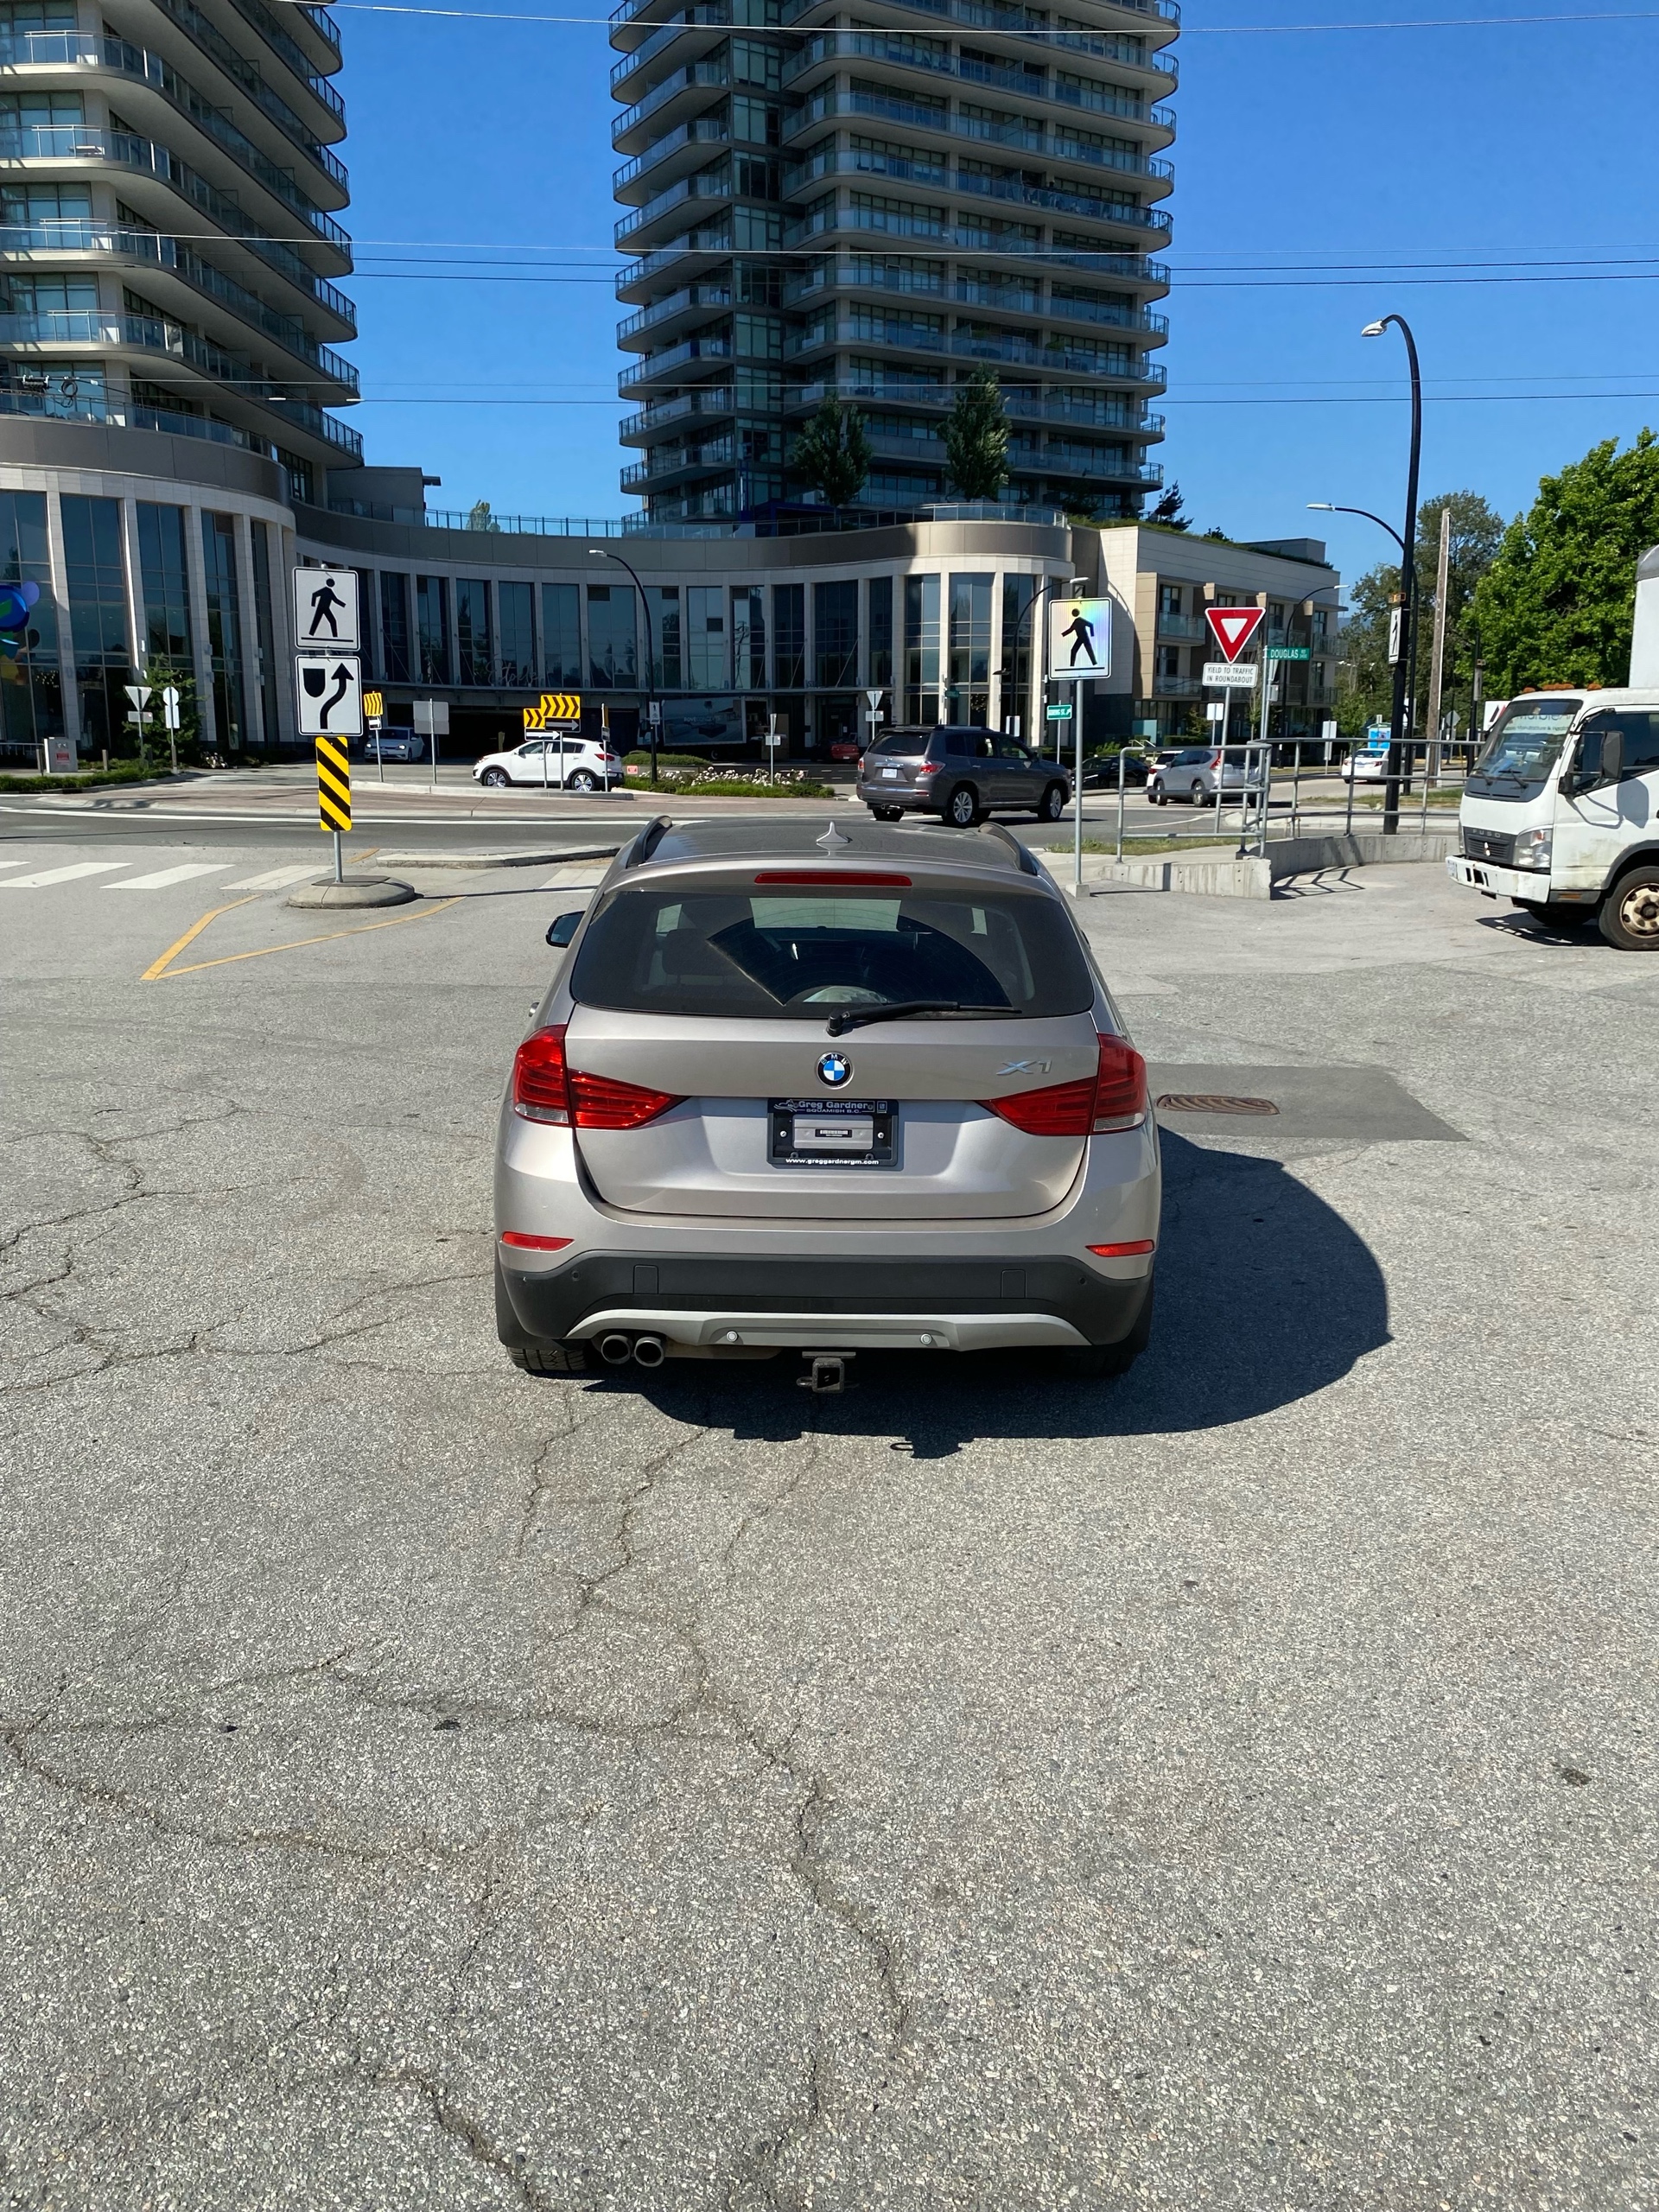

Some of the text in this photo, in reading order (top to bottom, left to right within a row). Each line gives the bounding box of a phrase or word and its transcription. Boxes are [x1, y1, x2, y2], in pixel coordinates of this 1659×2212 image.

[1270, 649, 1299, 658] DOUGLAS
[1472, 828, 1501, 838] FUSO
[820, 1053, 849, 1065] BMW
[995, 1060, 1052, 1075] X1
[798, 1101, 868, 1110] Greg Gardner
